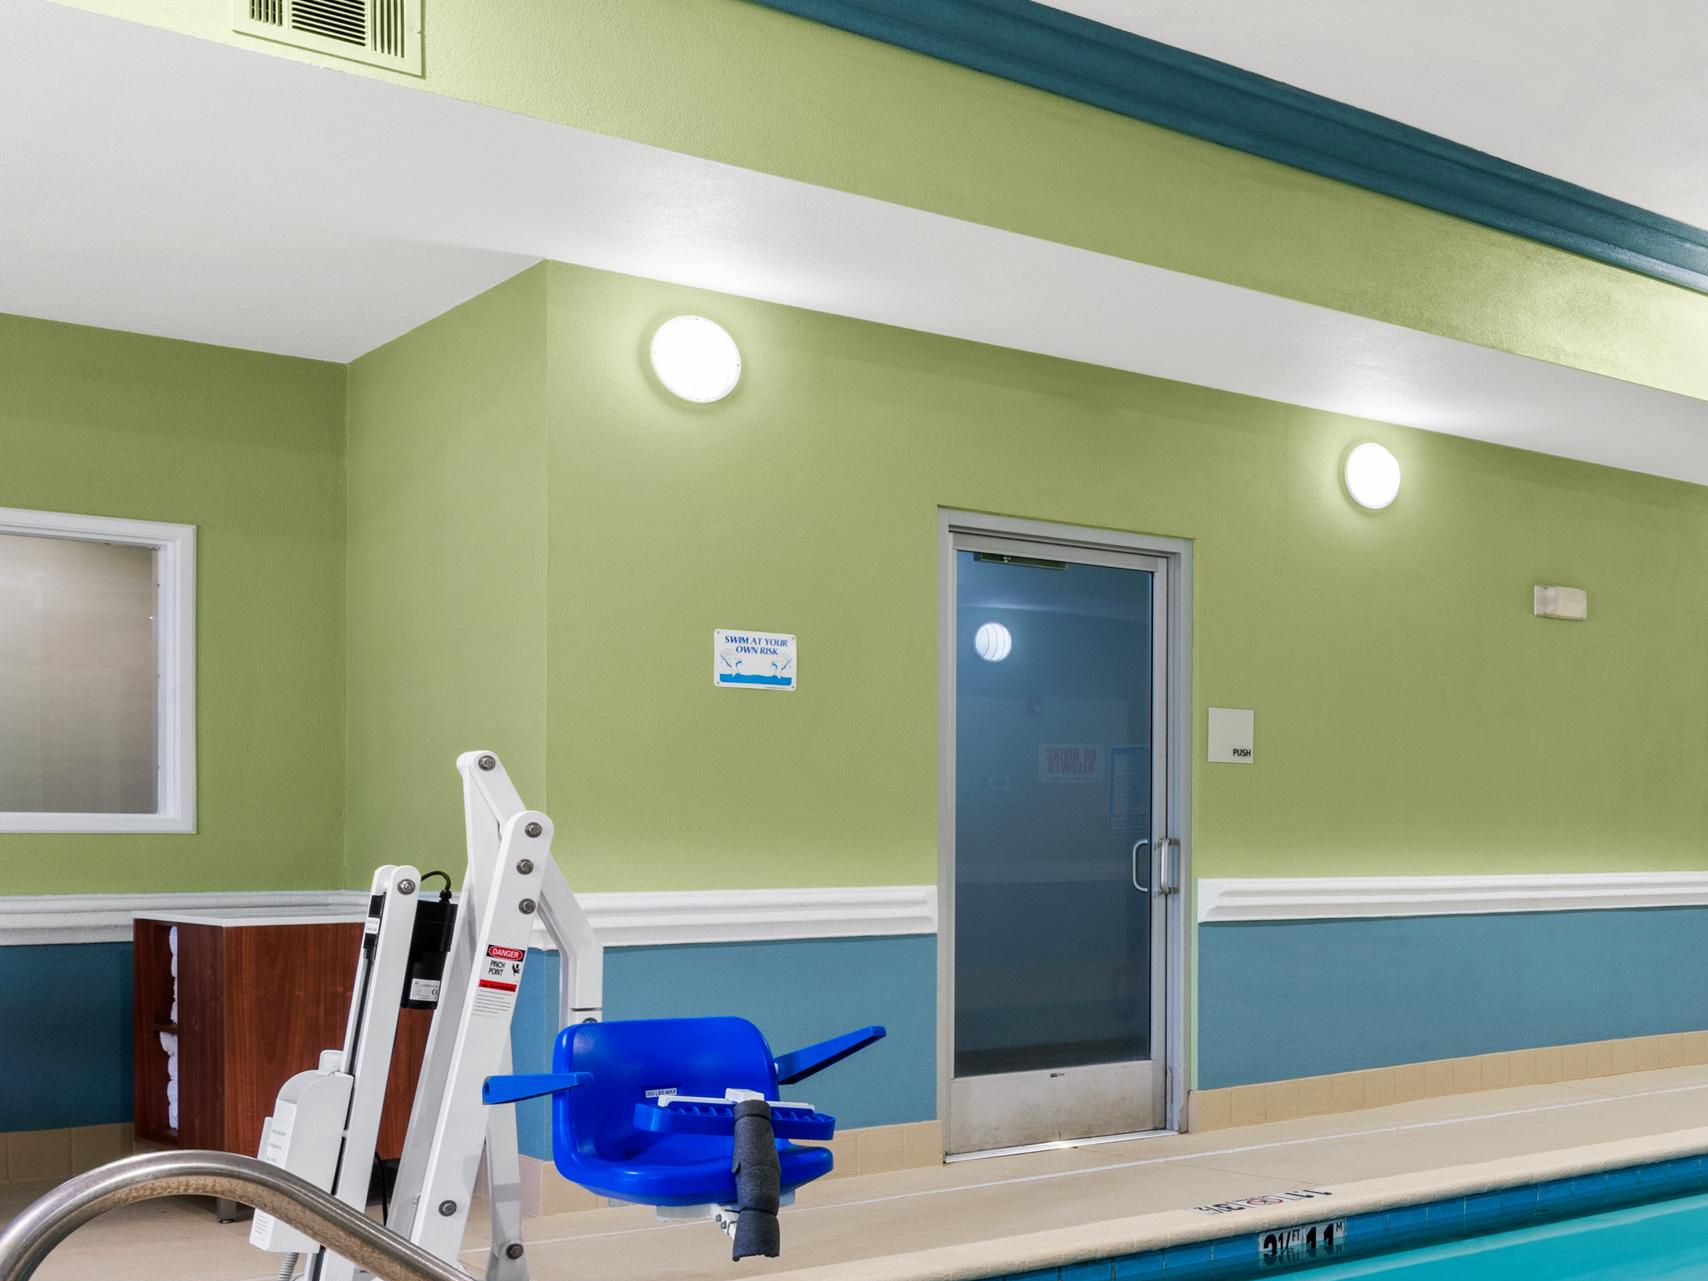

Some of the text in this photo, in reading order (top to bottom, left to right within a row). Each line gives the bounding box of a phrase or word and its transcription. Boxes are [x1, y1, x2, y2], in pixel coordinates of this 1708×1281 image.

[725, 635, 788, 647] SWIM AT YOUR
[735, 646, 778, 655] OWN RISK
[1233, 748, 1252, 757] PUSH
[492, 948, 519, 959] DANGER
[490, 960, 506, 969] PINCH
[488, 967, 504, 976] POINT
